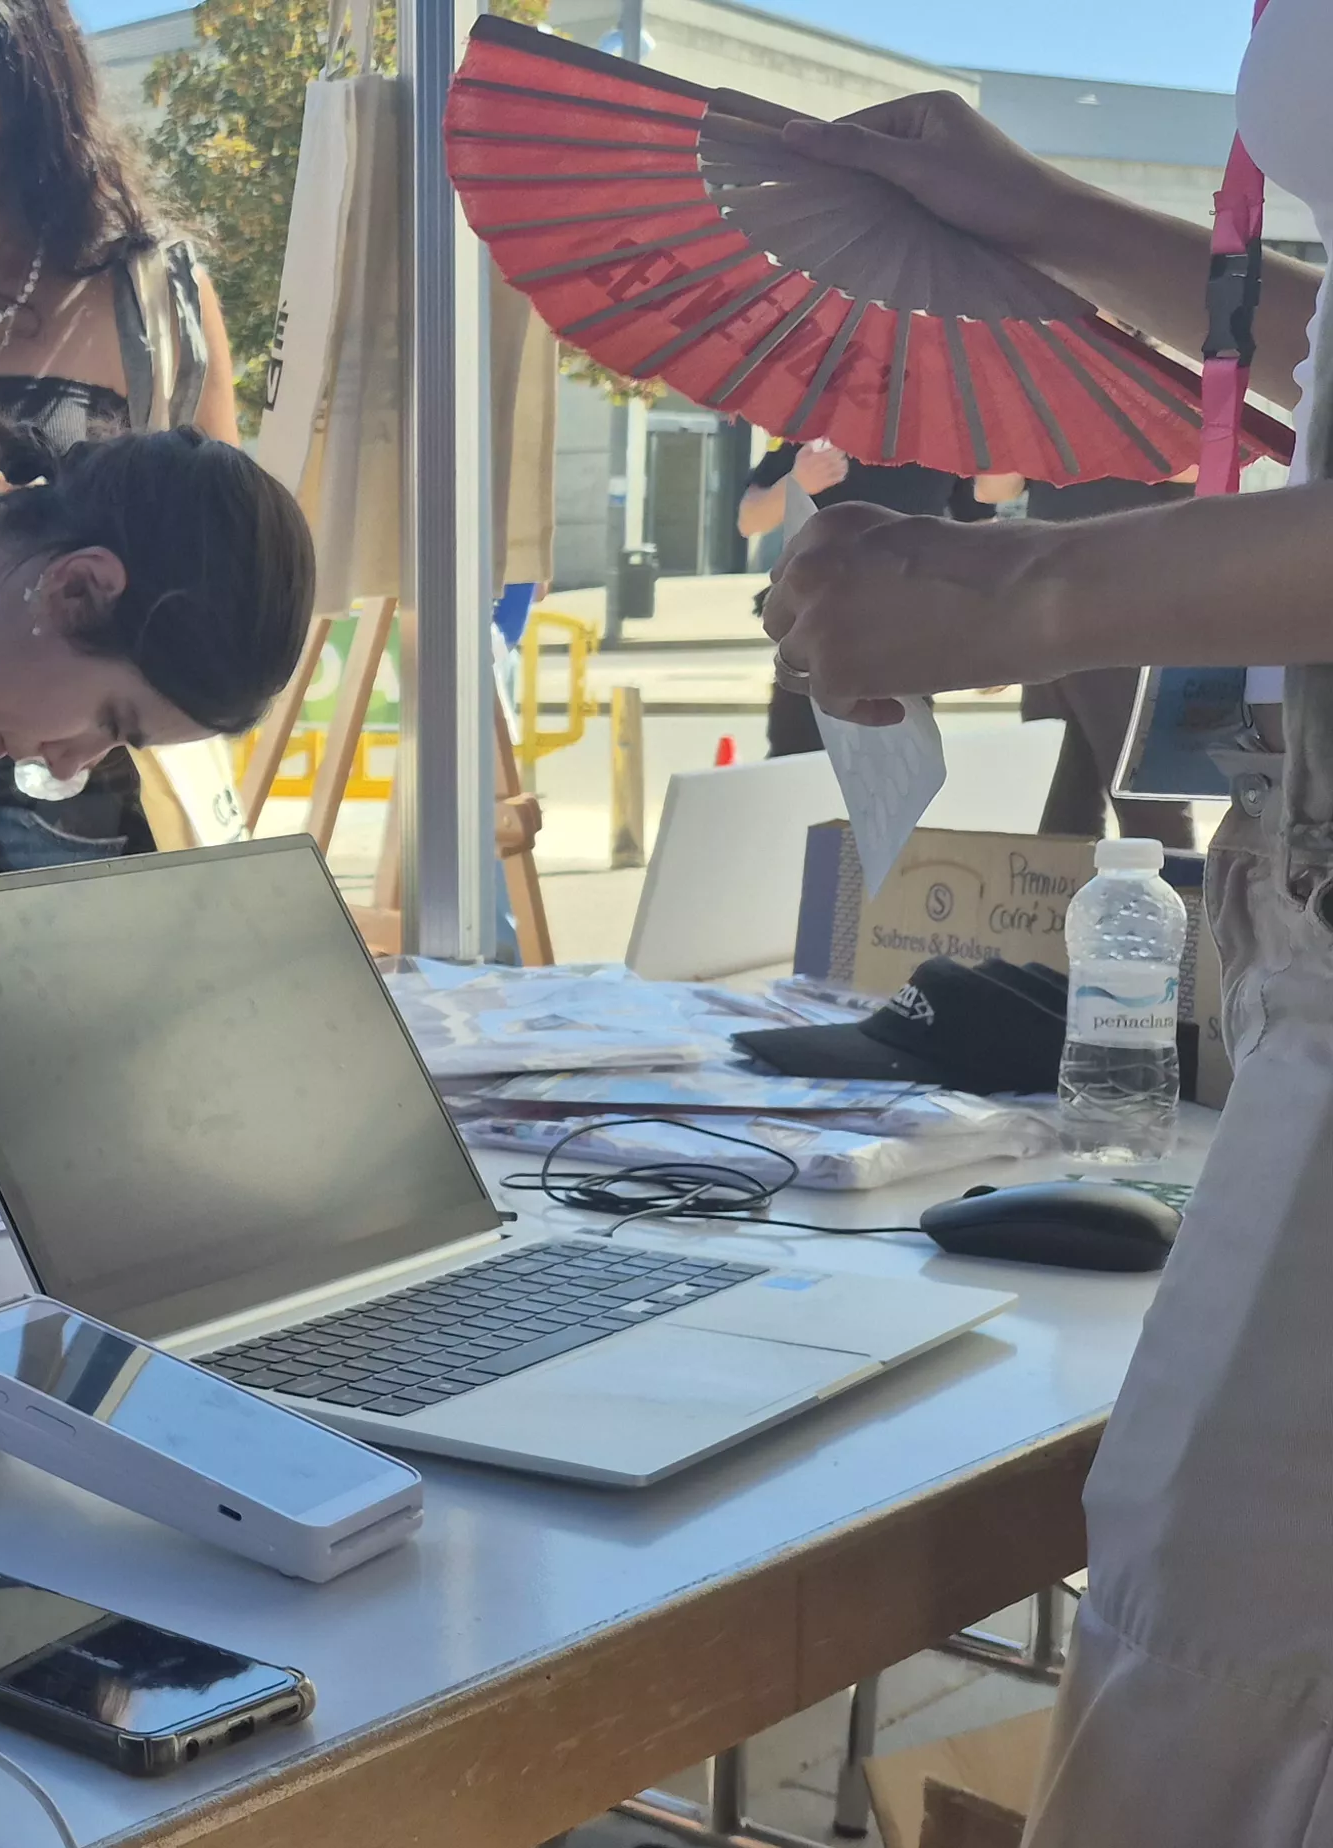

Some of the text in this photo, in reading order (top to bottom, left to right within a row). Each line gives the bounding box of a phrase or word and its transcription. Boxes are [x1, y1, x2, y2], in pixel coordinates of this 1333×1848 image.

[870, 925, 1002, 961] Sobres & Bolsas
[1093, 1012, 1174, 1030] peñaclara
[1207, 1016, 1223, 1043] S
